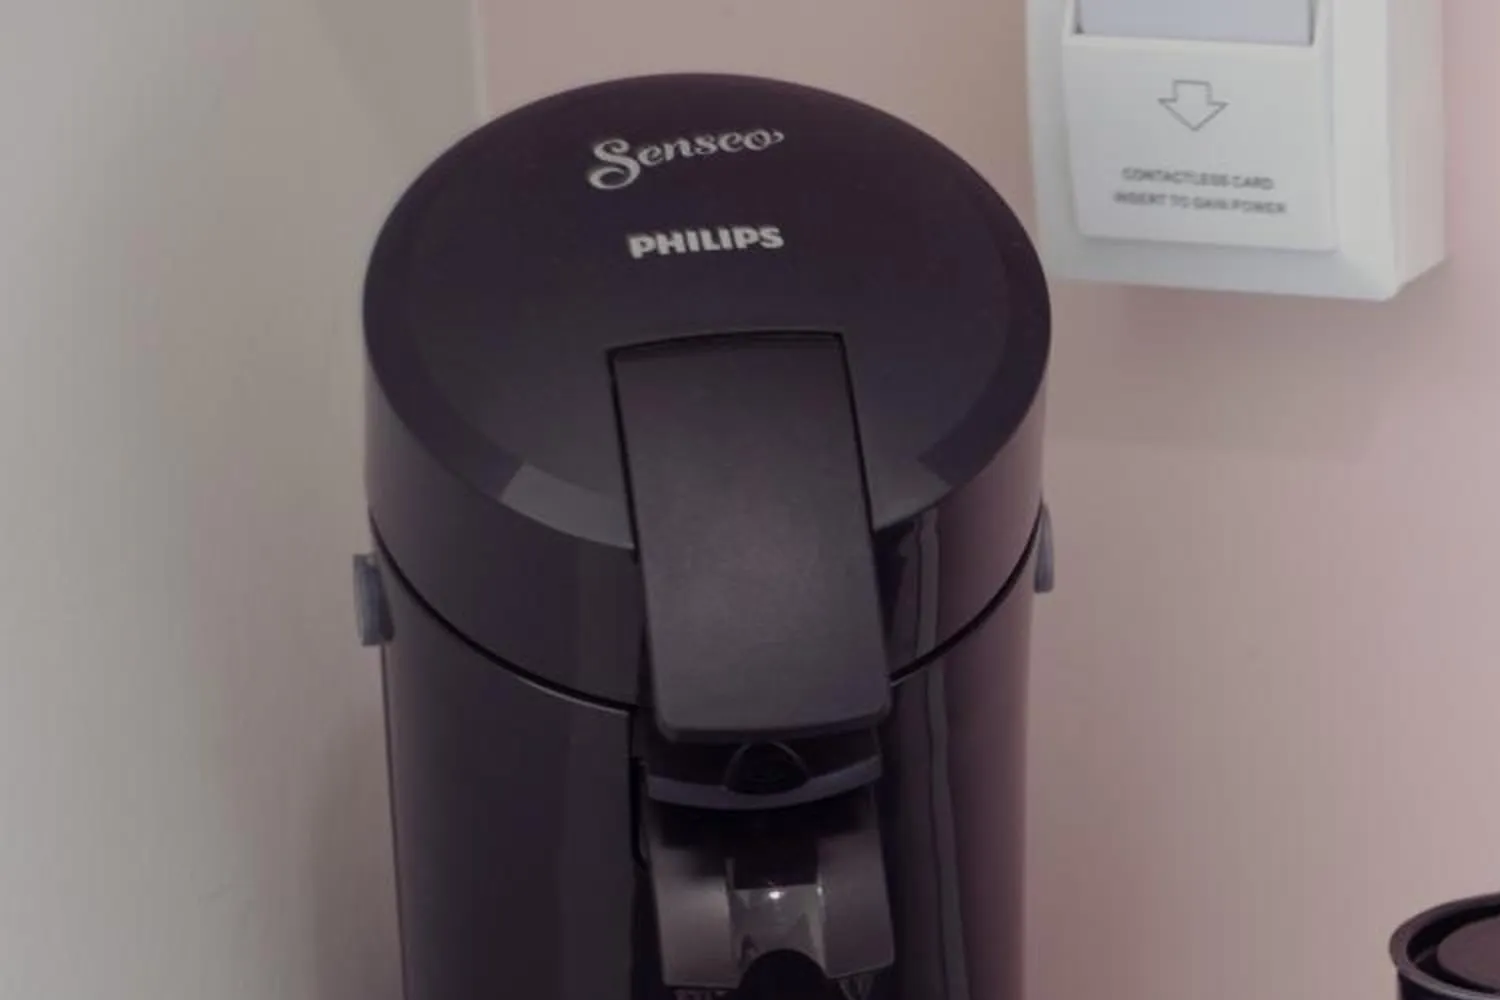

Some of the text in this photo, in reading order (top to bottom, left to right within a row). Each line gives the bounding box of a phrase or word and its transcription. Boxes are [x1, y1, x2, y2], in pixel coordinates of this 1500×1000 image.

[588, 128, 786, 190] Senseo
[1231, 175, 1275, 190] CARD
[1113, 191, 1167, 206] INSERT
[628, 226, 785, 259] PHILIPS
